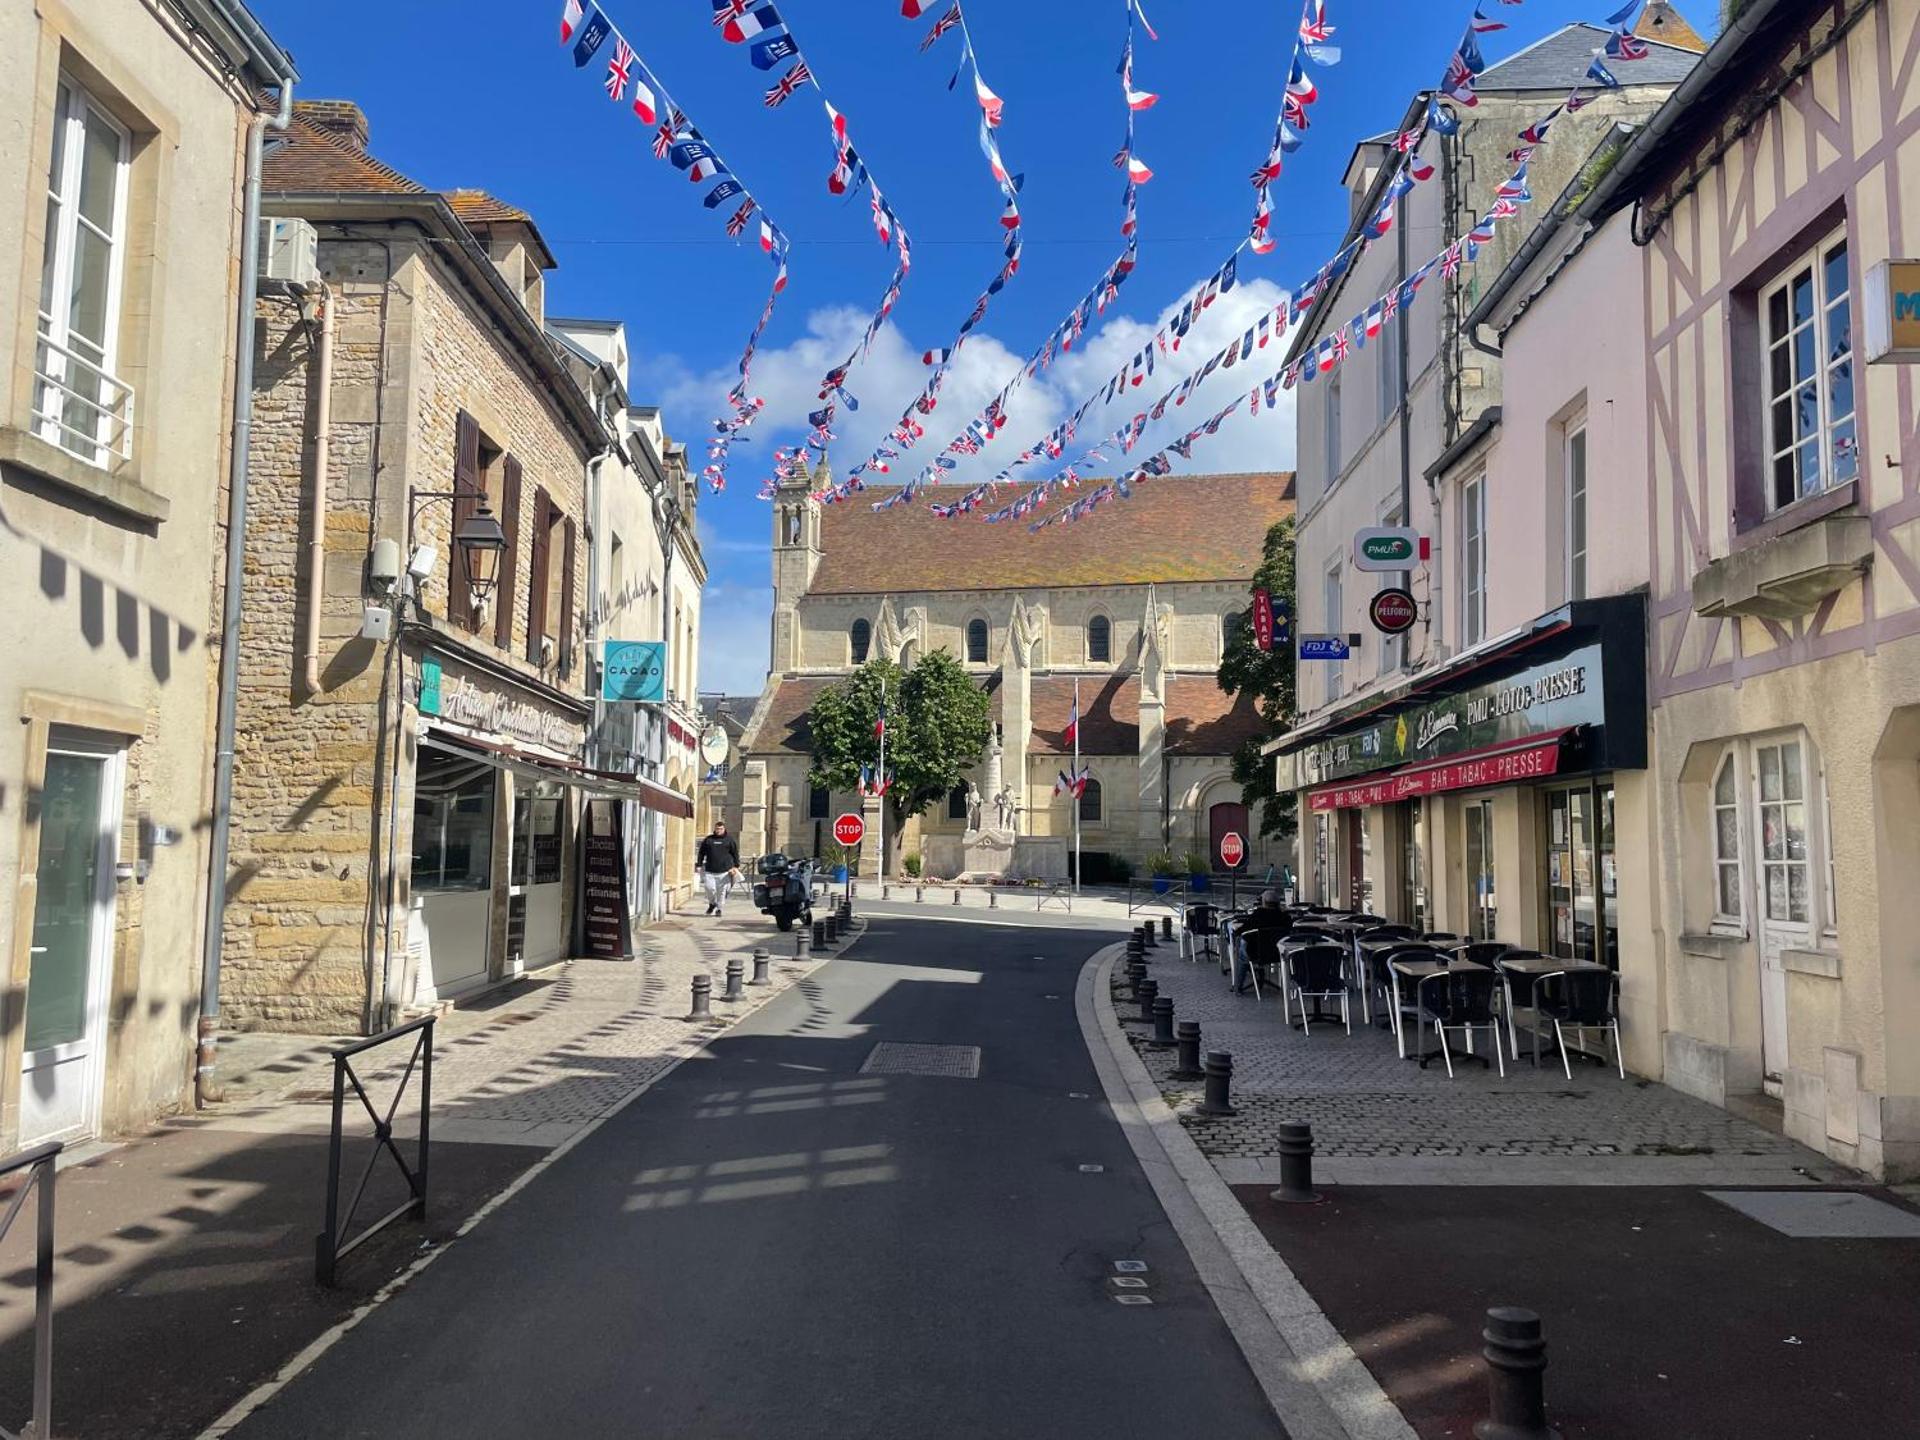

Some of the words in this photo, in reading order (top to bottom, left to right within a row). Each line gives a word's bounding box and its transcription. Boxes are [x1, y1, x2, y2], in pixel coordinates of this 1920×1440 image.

[1368, 545, 1390, 554] PMU
[1378, 607, 1412, 616] PELFORTH
[1259, 596, 1269, 642] TABAC
[1306, 642, 1326, 651] FDJ
[609, 666, 659, 676] CACAO
[1467, 698, 1488, 726] PMU
[1535, 666, 1581, 705] PRESSE
[1431, 770, 1447, 789] BAR
[1458, 762, 1486, 783] TABAC
[1499, 751, 1543, 777] PRESSE
[837, 825, 861, 834] STOP
[1224, 844, 1240, 854] STOP
